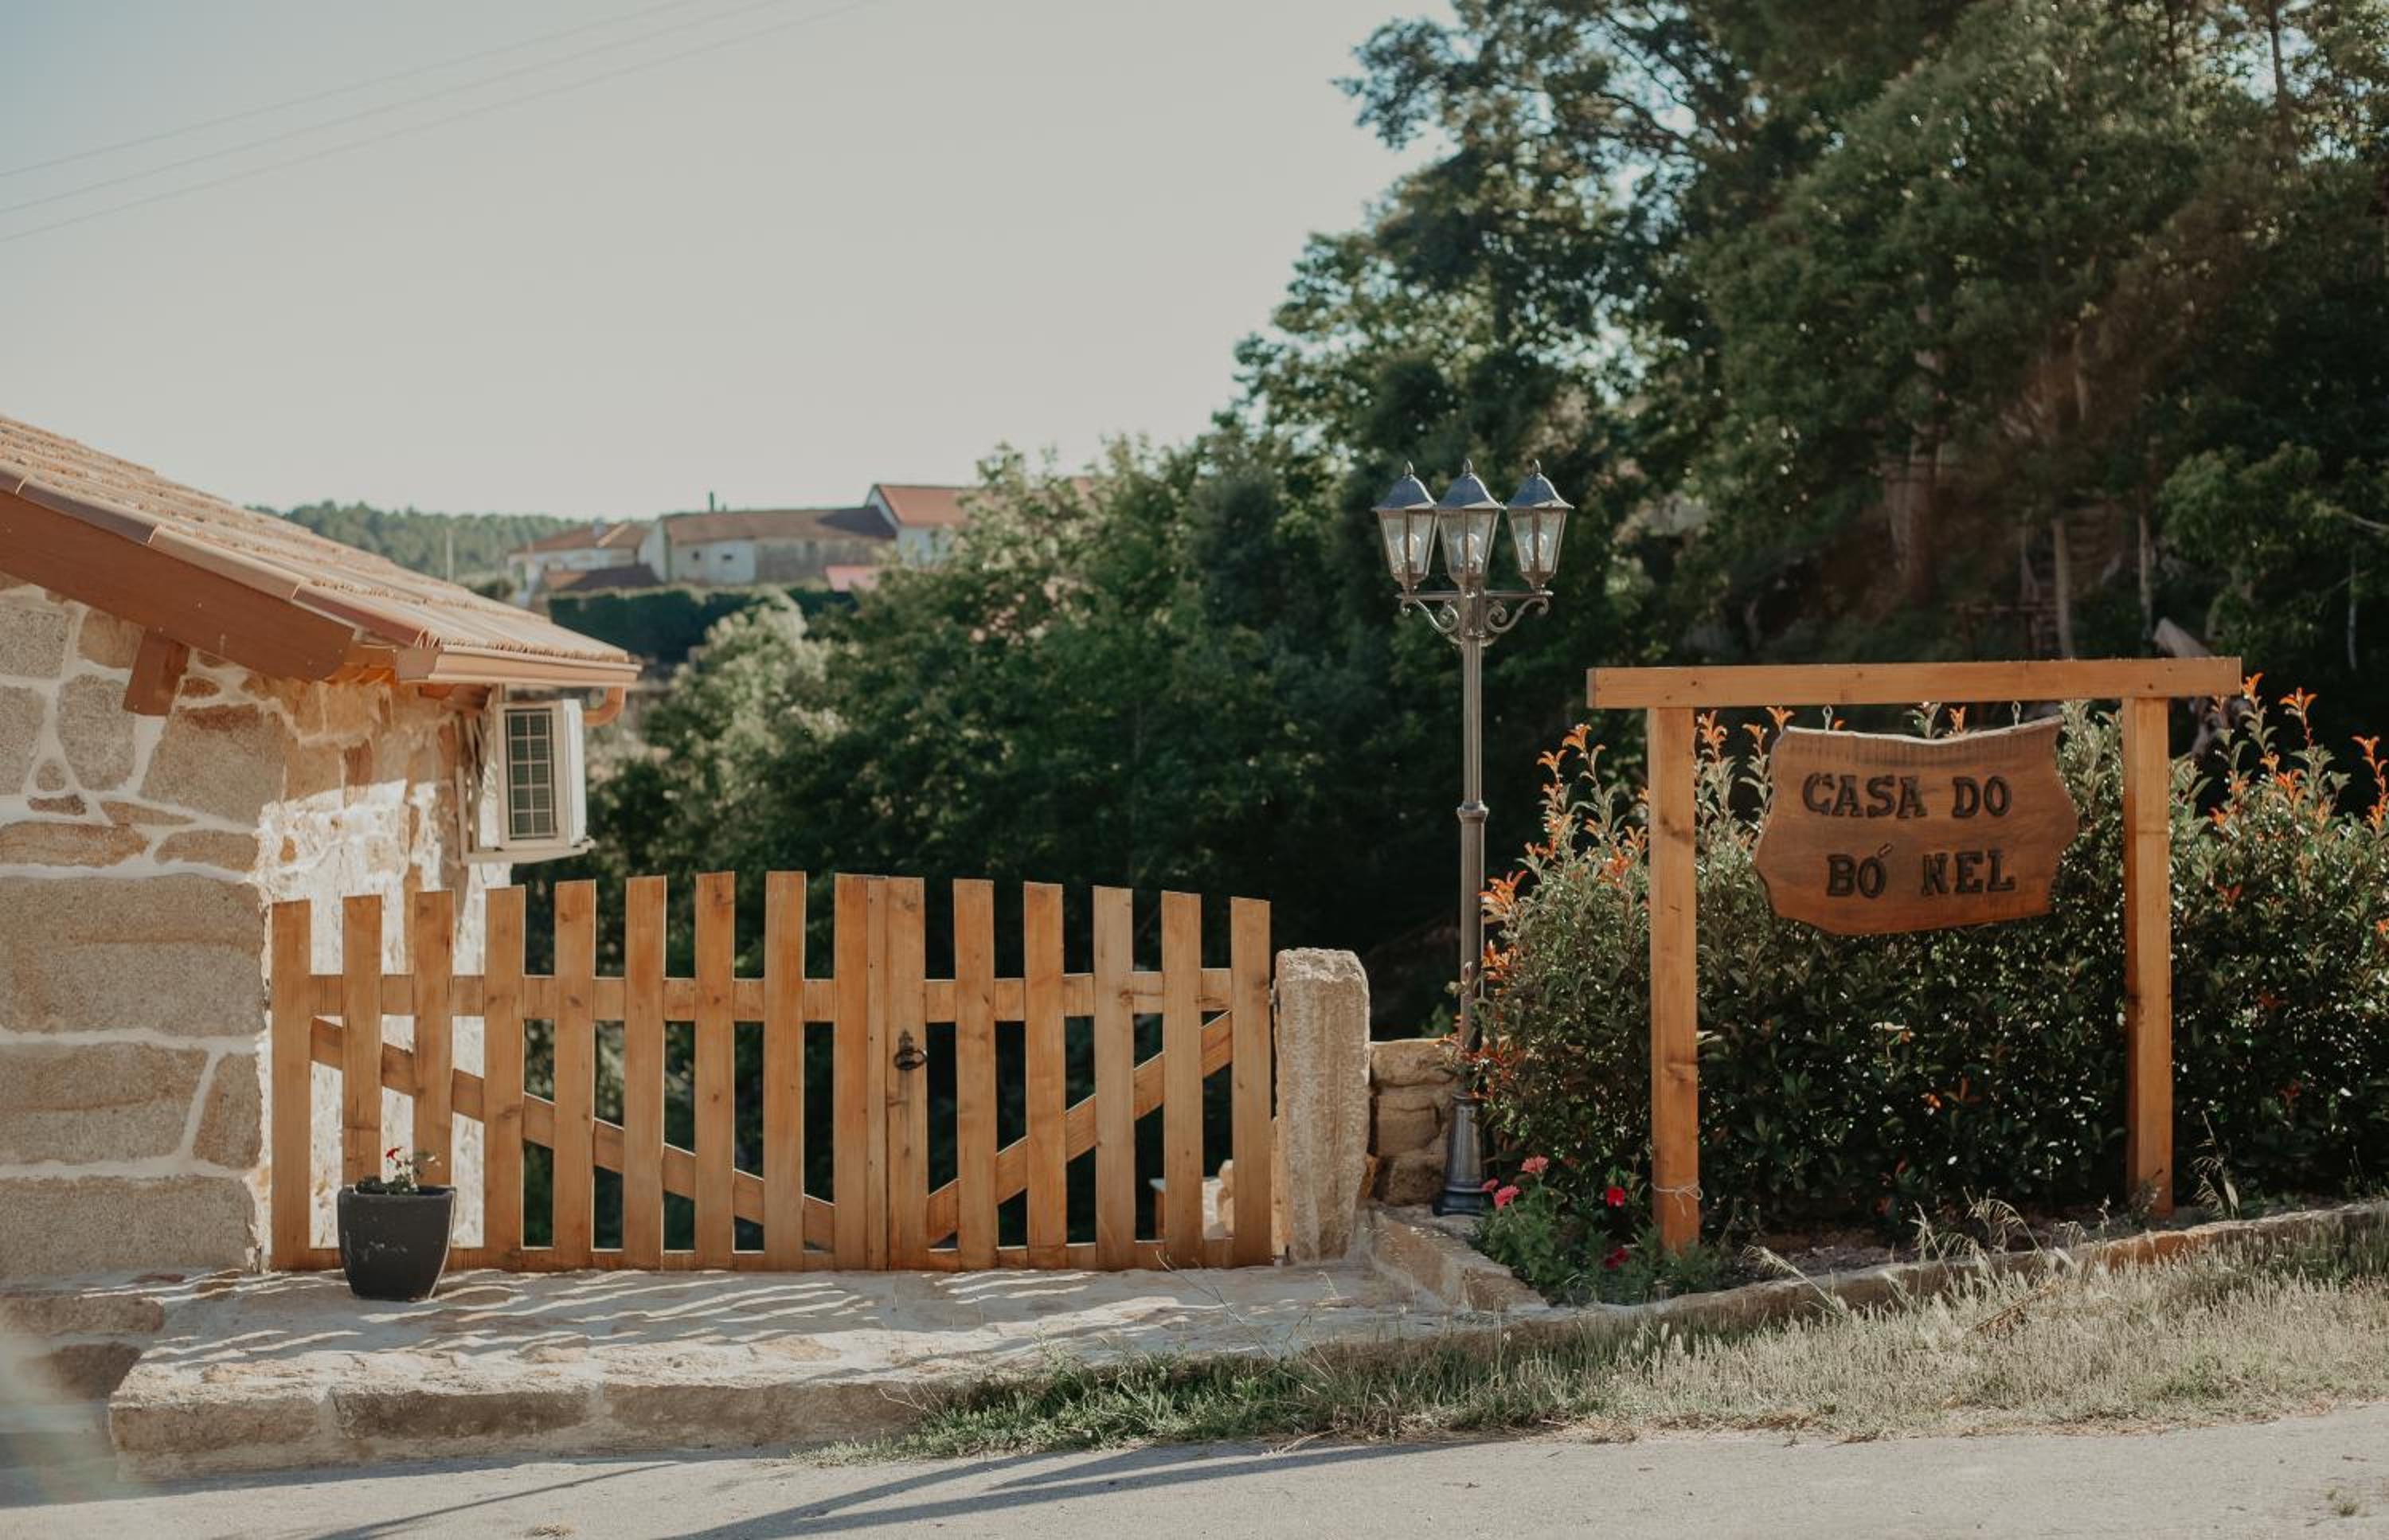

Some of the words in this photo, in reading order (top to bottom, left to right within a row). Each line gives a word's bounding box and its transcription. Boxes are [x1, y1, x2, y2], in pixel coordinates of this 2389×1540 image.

[1802, 772, 1927, 819] CASA
[1951, 775, 2012, 819] DO
[1826, 842, 1894, 899] BÓ
[1920, 850, 2016, 897] NEL
